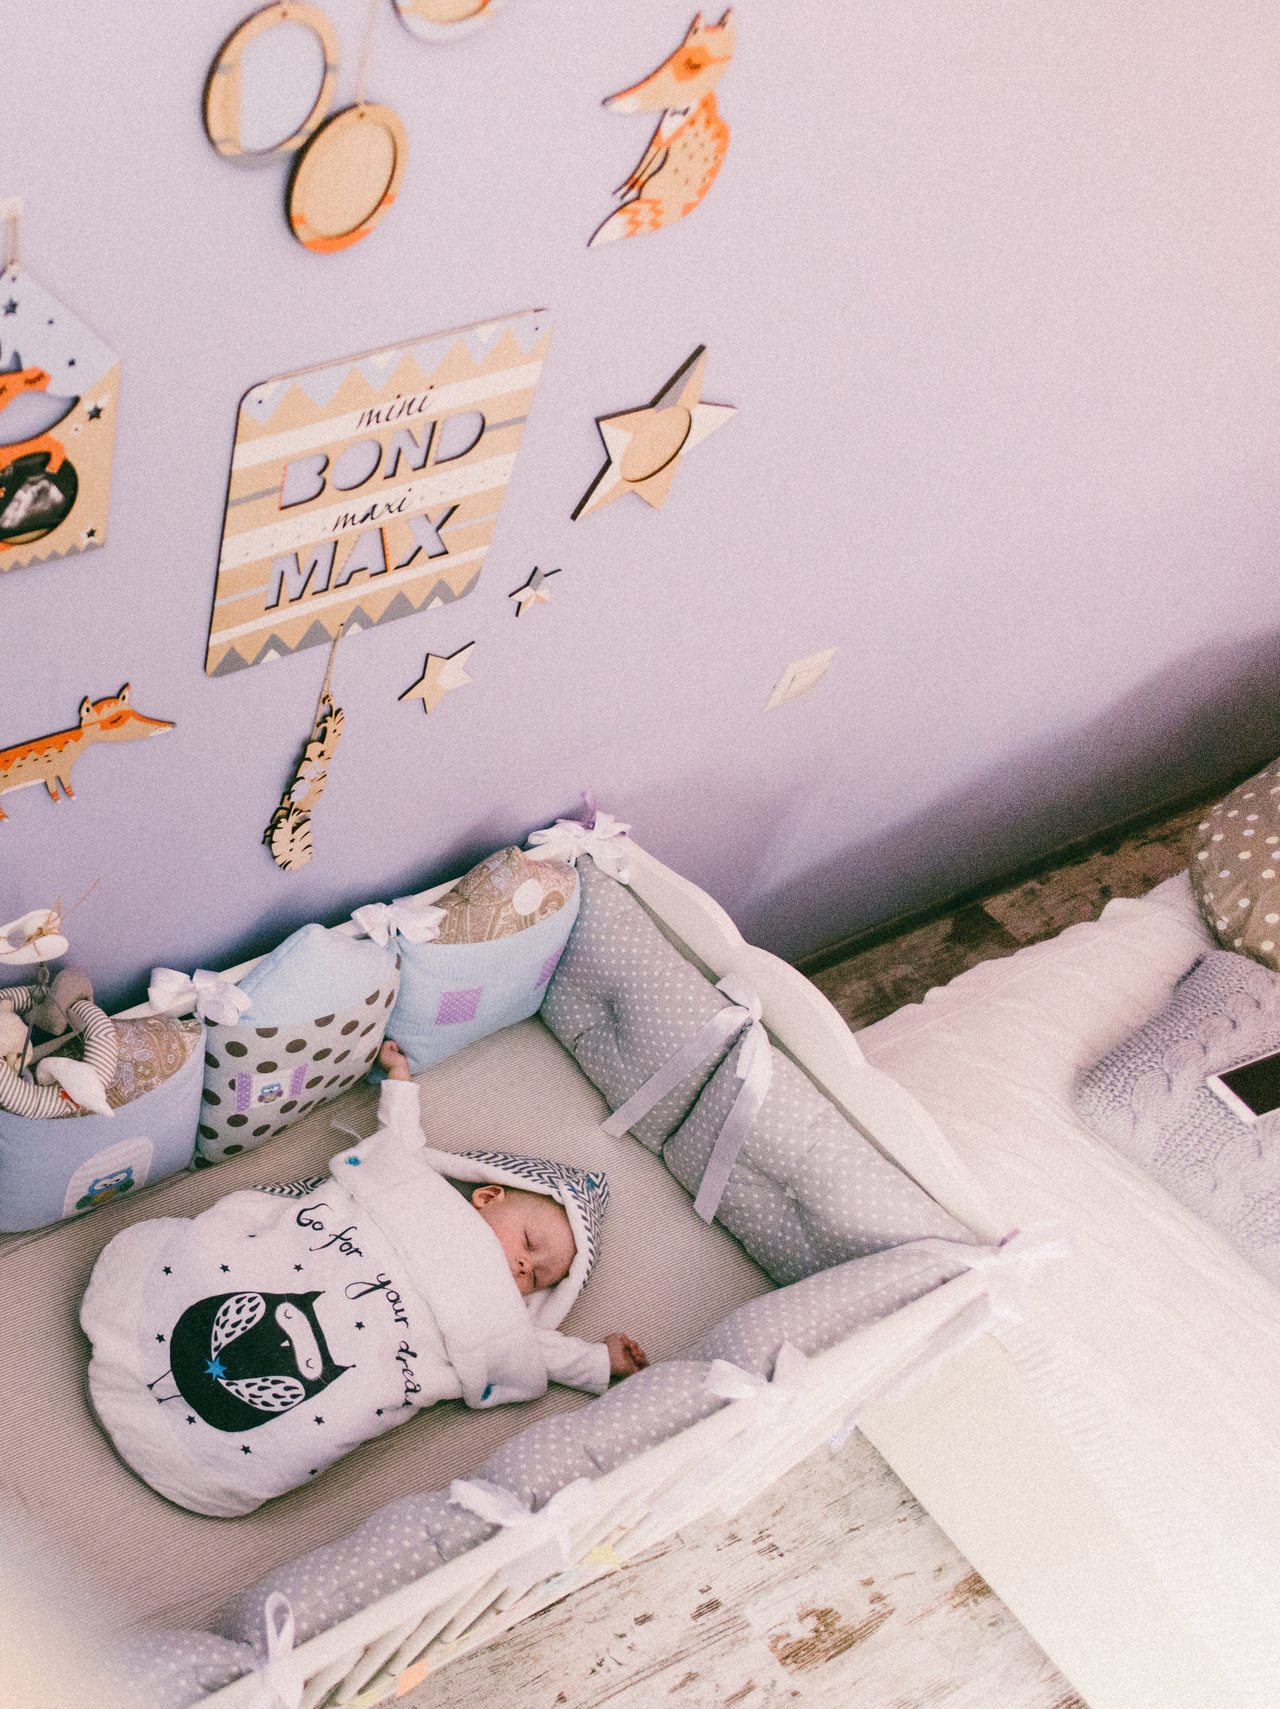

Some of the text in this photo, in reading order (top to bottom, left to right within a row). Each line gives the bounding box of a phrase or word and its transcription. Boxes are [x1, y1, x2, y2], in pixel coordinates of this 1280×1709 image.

[356, 385, 434, 430] mini
[278, 410, 487, 511] BOND
[332, 488, 413, 532] maxi
[264, 503, 461, 611] MAX
[296, 1203, 335, 1231] Go
[309, 1226, 364, 1257] for
[345, 1273, 409, 1329] your
